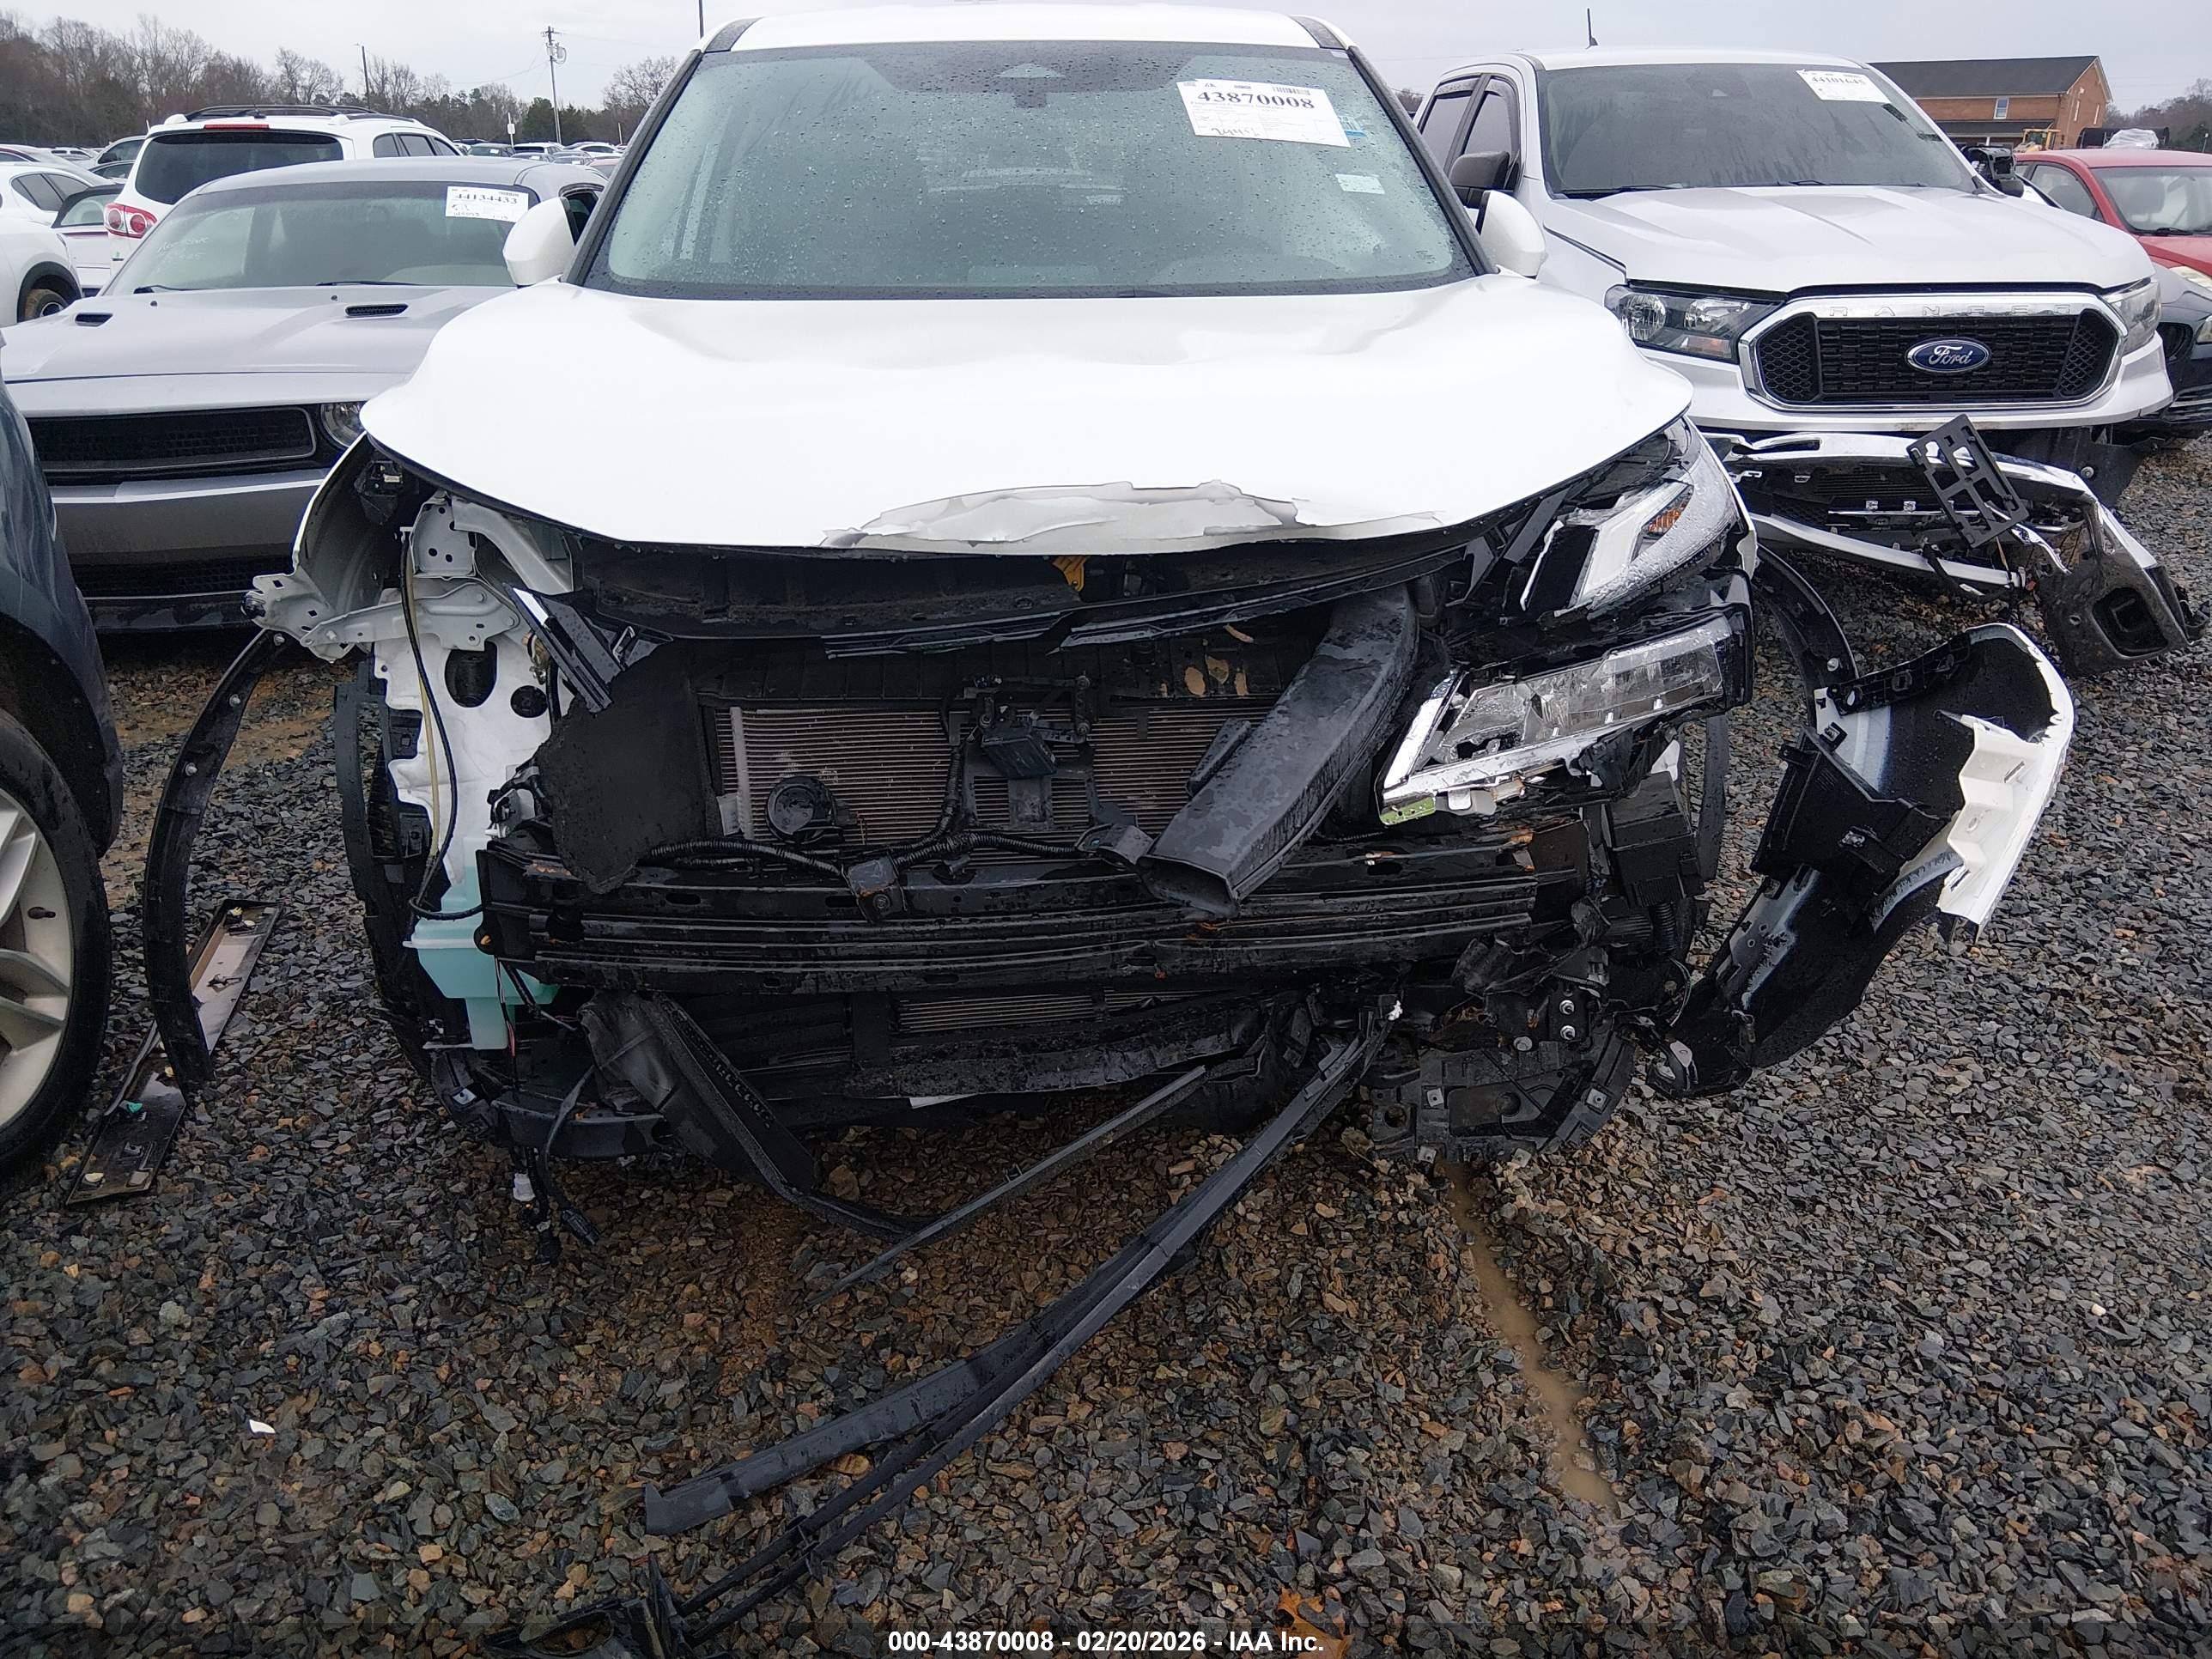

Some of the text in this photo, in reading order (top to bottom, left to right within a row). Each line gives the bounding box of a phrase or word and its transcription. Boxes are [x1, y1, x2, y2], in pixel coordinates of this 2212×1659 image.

[1197, 91, 1316, 109] 43870008
[455, 194, 517, 204] 44134433
[1829, 303, 2072, 317] RANGER
[1928, 344, 1973, 366] Ford
